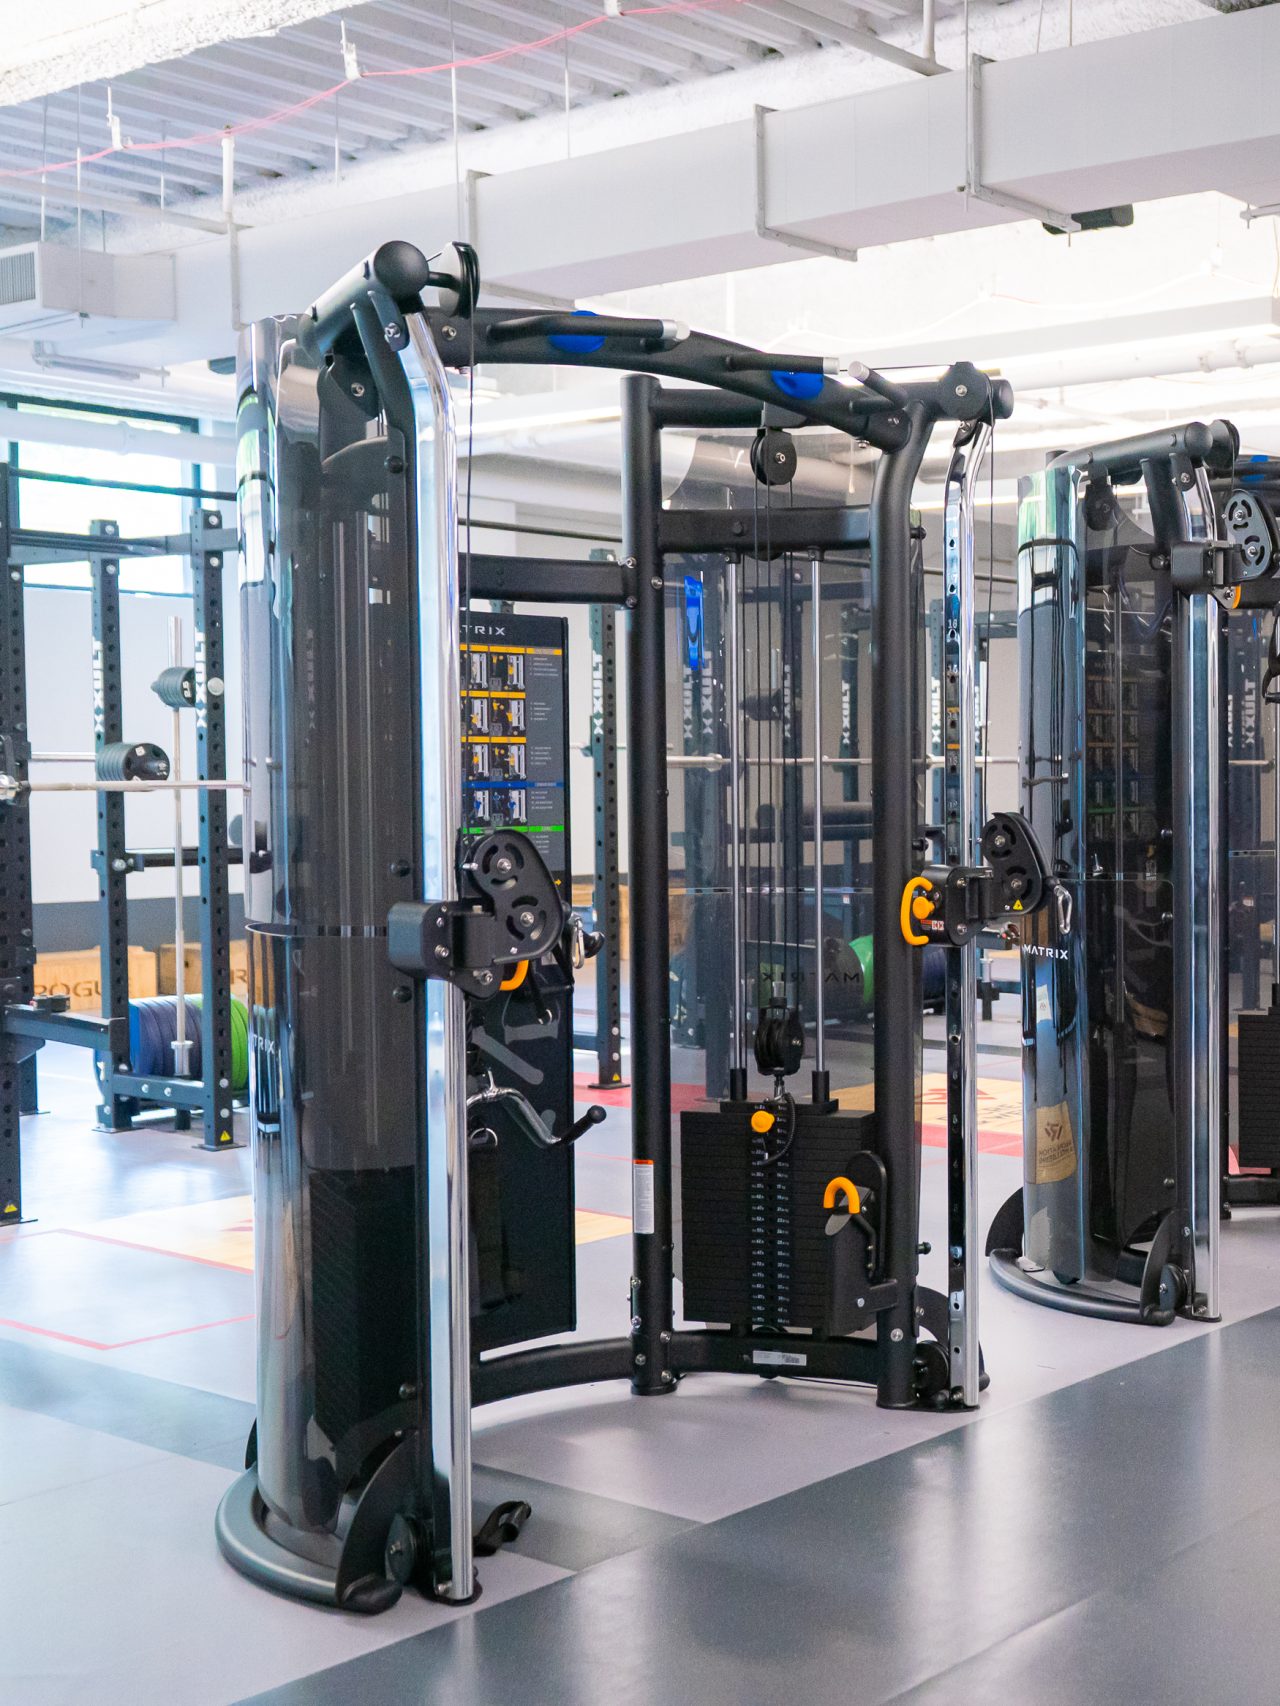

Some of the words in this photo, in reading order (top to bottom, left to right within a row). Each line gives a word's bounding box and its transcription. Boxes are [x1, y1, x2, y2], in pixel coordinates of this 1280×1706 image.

[460, 624, 505, 636] TRIX
[592, 649, 603, 714] XULT
[1021, 943, 1069, 960] MATRIX
[253, 1033, 275, 1055] TRIX
